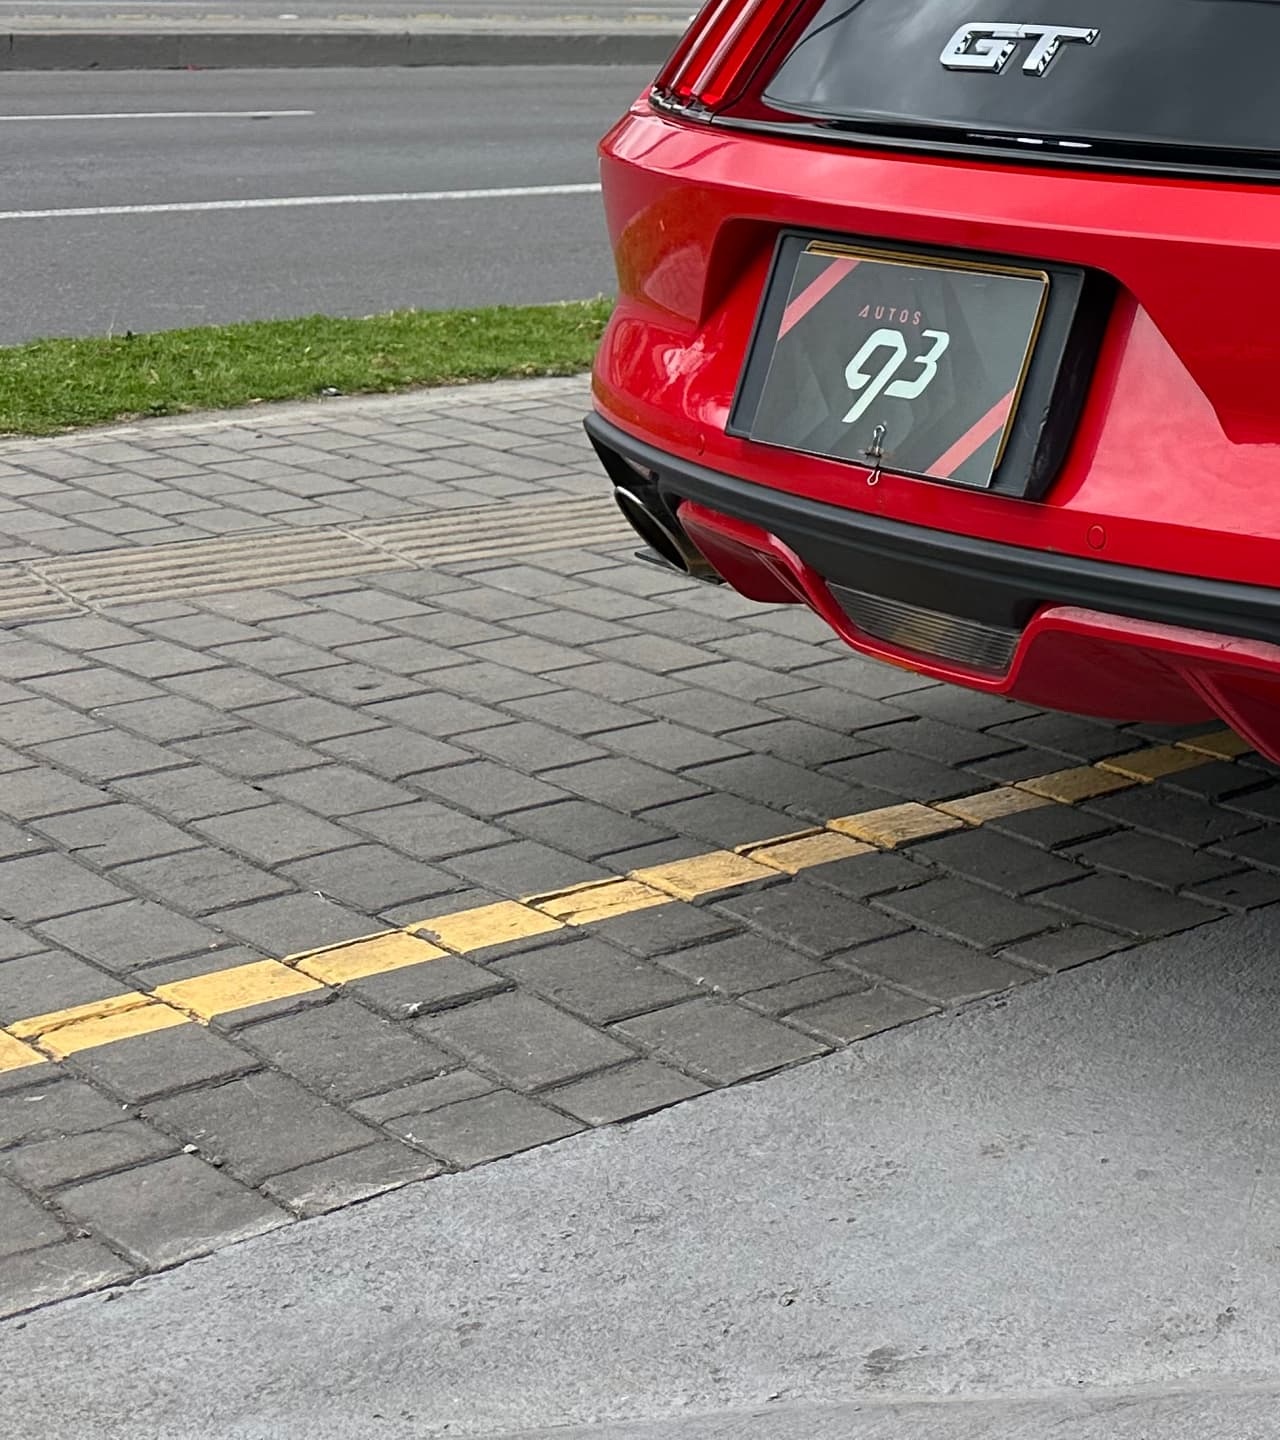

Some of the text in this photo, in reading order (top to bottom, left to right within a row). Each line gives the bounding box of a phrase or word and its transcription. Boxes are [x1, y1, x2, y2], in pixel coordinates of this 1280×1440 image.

[939, 22, 1101, 78] GT
[858, 304, 922, 325] AUTOS
[842, 328, 950, 423] 93
